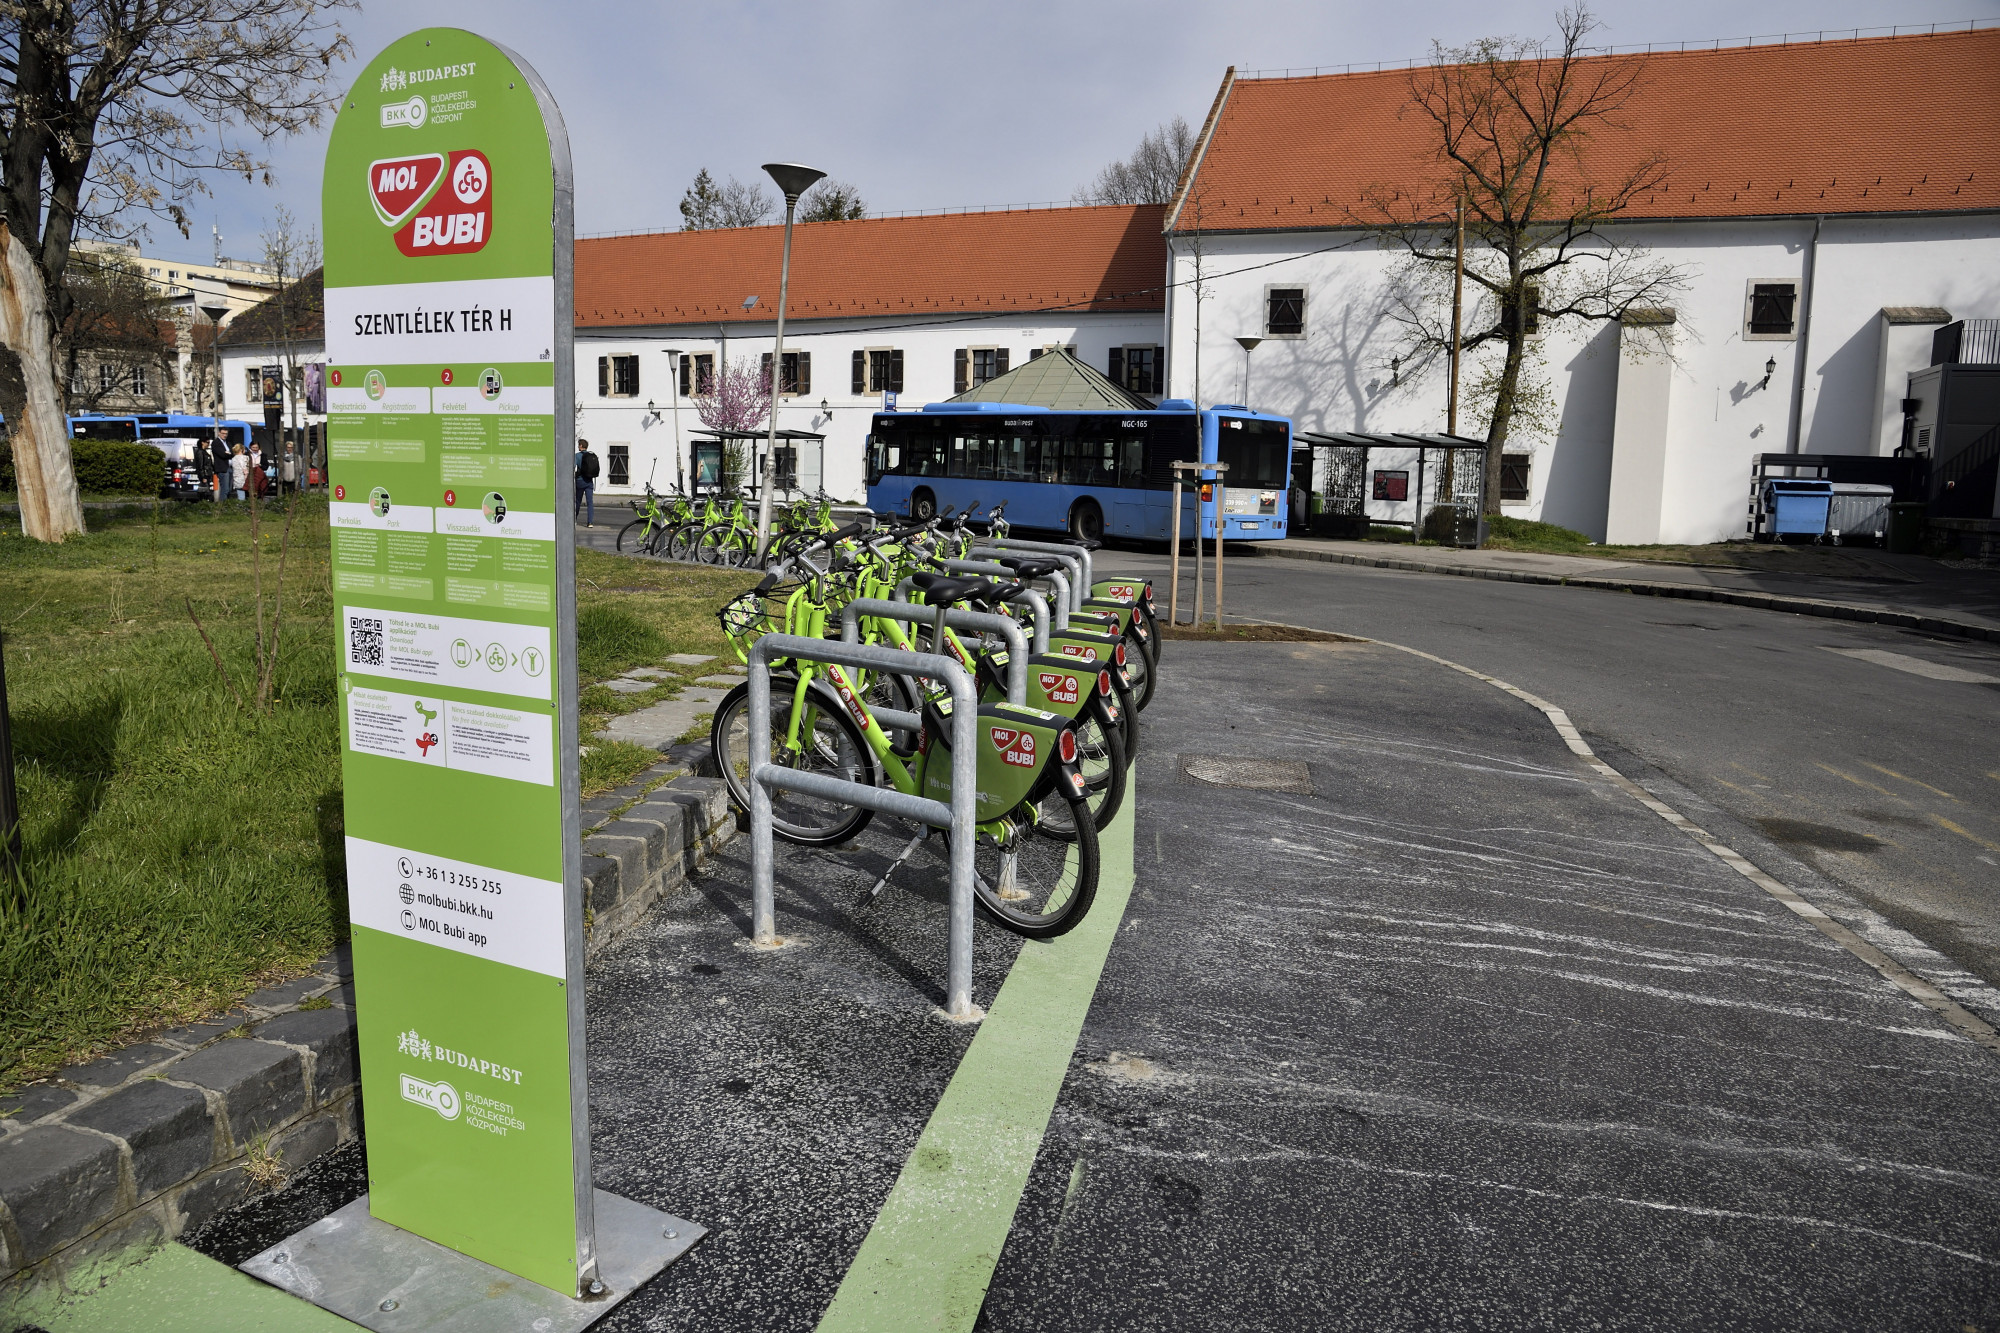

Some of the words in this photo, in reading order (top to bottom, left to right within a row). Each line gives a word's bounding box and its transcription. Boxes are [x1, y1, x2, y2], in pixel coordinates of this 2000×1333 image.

[409, 62, 476, 84] BUDAPEST
[430, 90, 468, 103] BUDAPESTI
[386, 109, 406, 121] BKK
[430, 100, 477, 114] KÖZLEKEDÉSI
[431, 112, 463, 124] KÖZPONT
[378, 165, 418, 193] MOL
[412, 211, 486, 248] BUBI
[354, 306, 455, 336] SZENTLÉLEK
[460, 304, 494, 333] TÉR
[500, 308, 512, 332] H
[382, 402, 416, 412] Registration
[442, 402, 467, 411] Felvétel
[498, 402, 520, 413] Pickup
[1121, 420, 1148, 428] NGC-165
[337, 516, 362, 525] Parkolás
[387, 519, 400, 528] Park
[446, 523, 481, 533] Visszaadás
[501, 526, 522, 535] Return
[829, 667, 840, 680] MOL
[1041, 675, 1055, 684] MOL
[1052, 691, 1077, 702] BUBI
[847, 700, 867, 726] BUBI
[994, 730, 1009, 741] MOL
[1006, 750, 1035, 766] BUBI
[426, 866, 438, 880] 36
[441, 870, 446, 882] 1
[449, 871, 455, 884] 3
[458, 873, 478, 890] 255
[482, 879, 502, 895] 255
[417, 893, 493, 920] molbubi.bkk.hu
[419, 916, 441, 933] MOL
[444, 923, 465, 940] Bubi
[468, 931, 487, 948] app
[434, 1045, 523, 1085] BUDAPEST
[408, 1083, 433, 1102] BKK
[465, 1091, 514, 1115] BUDAPESTI
[465, 1103, 525, 1131] KÖZLEKEDÉSI
[466, 1115, 508, 1136] KÖZPONT
